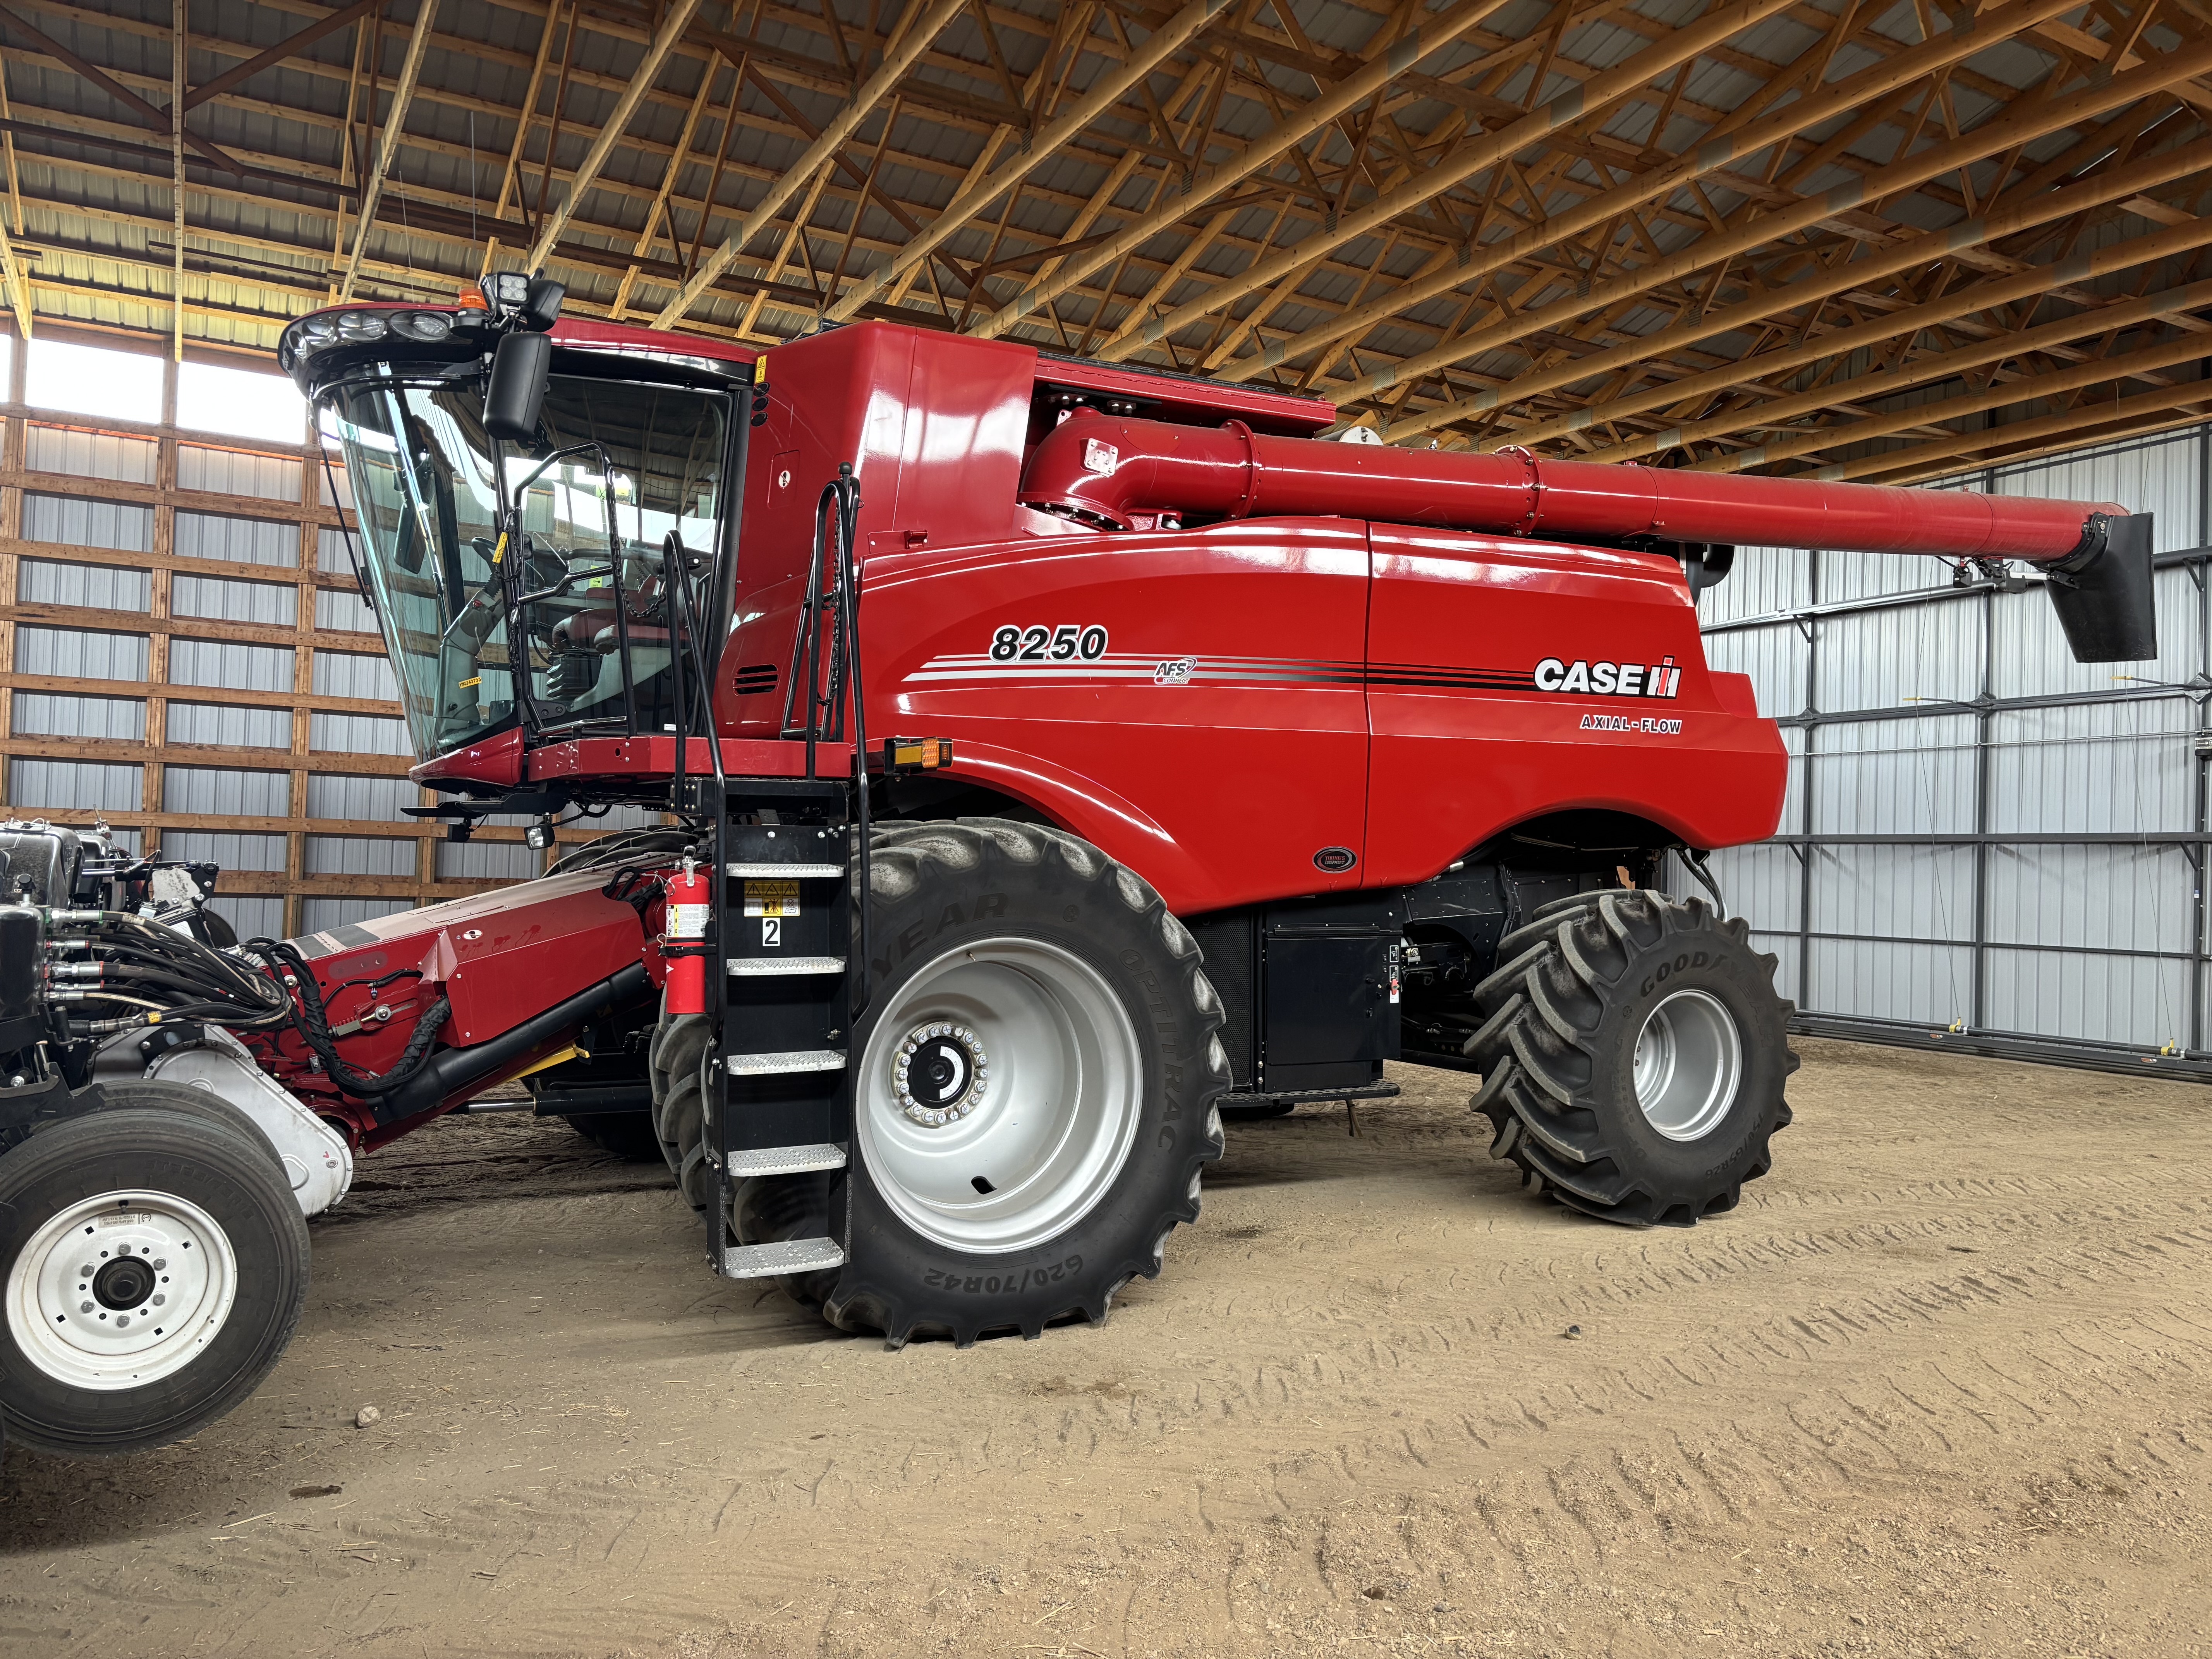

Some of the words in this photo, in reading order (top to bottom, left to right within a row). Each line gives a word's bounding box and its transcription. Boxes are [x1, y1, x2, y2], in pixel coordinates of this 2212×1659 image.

[989, 624, 1109, 663] 8250
[1155, 661, 1187, 676] AFS
[1535, 659, 1644, 695] CASE
[1580, 714, 1682, 734] AXIAL-FLOW
[765, 920, 778, 944] 2
[1119, 949, 1183, 1154] OPTITRAC
[1705, 1113, 1764, 1179] 750/65R26
[924, 1254, 1083, 1294] 620/70R42
